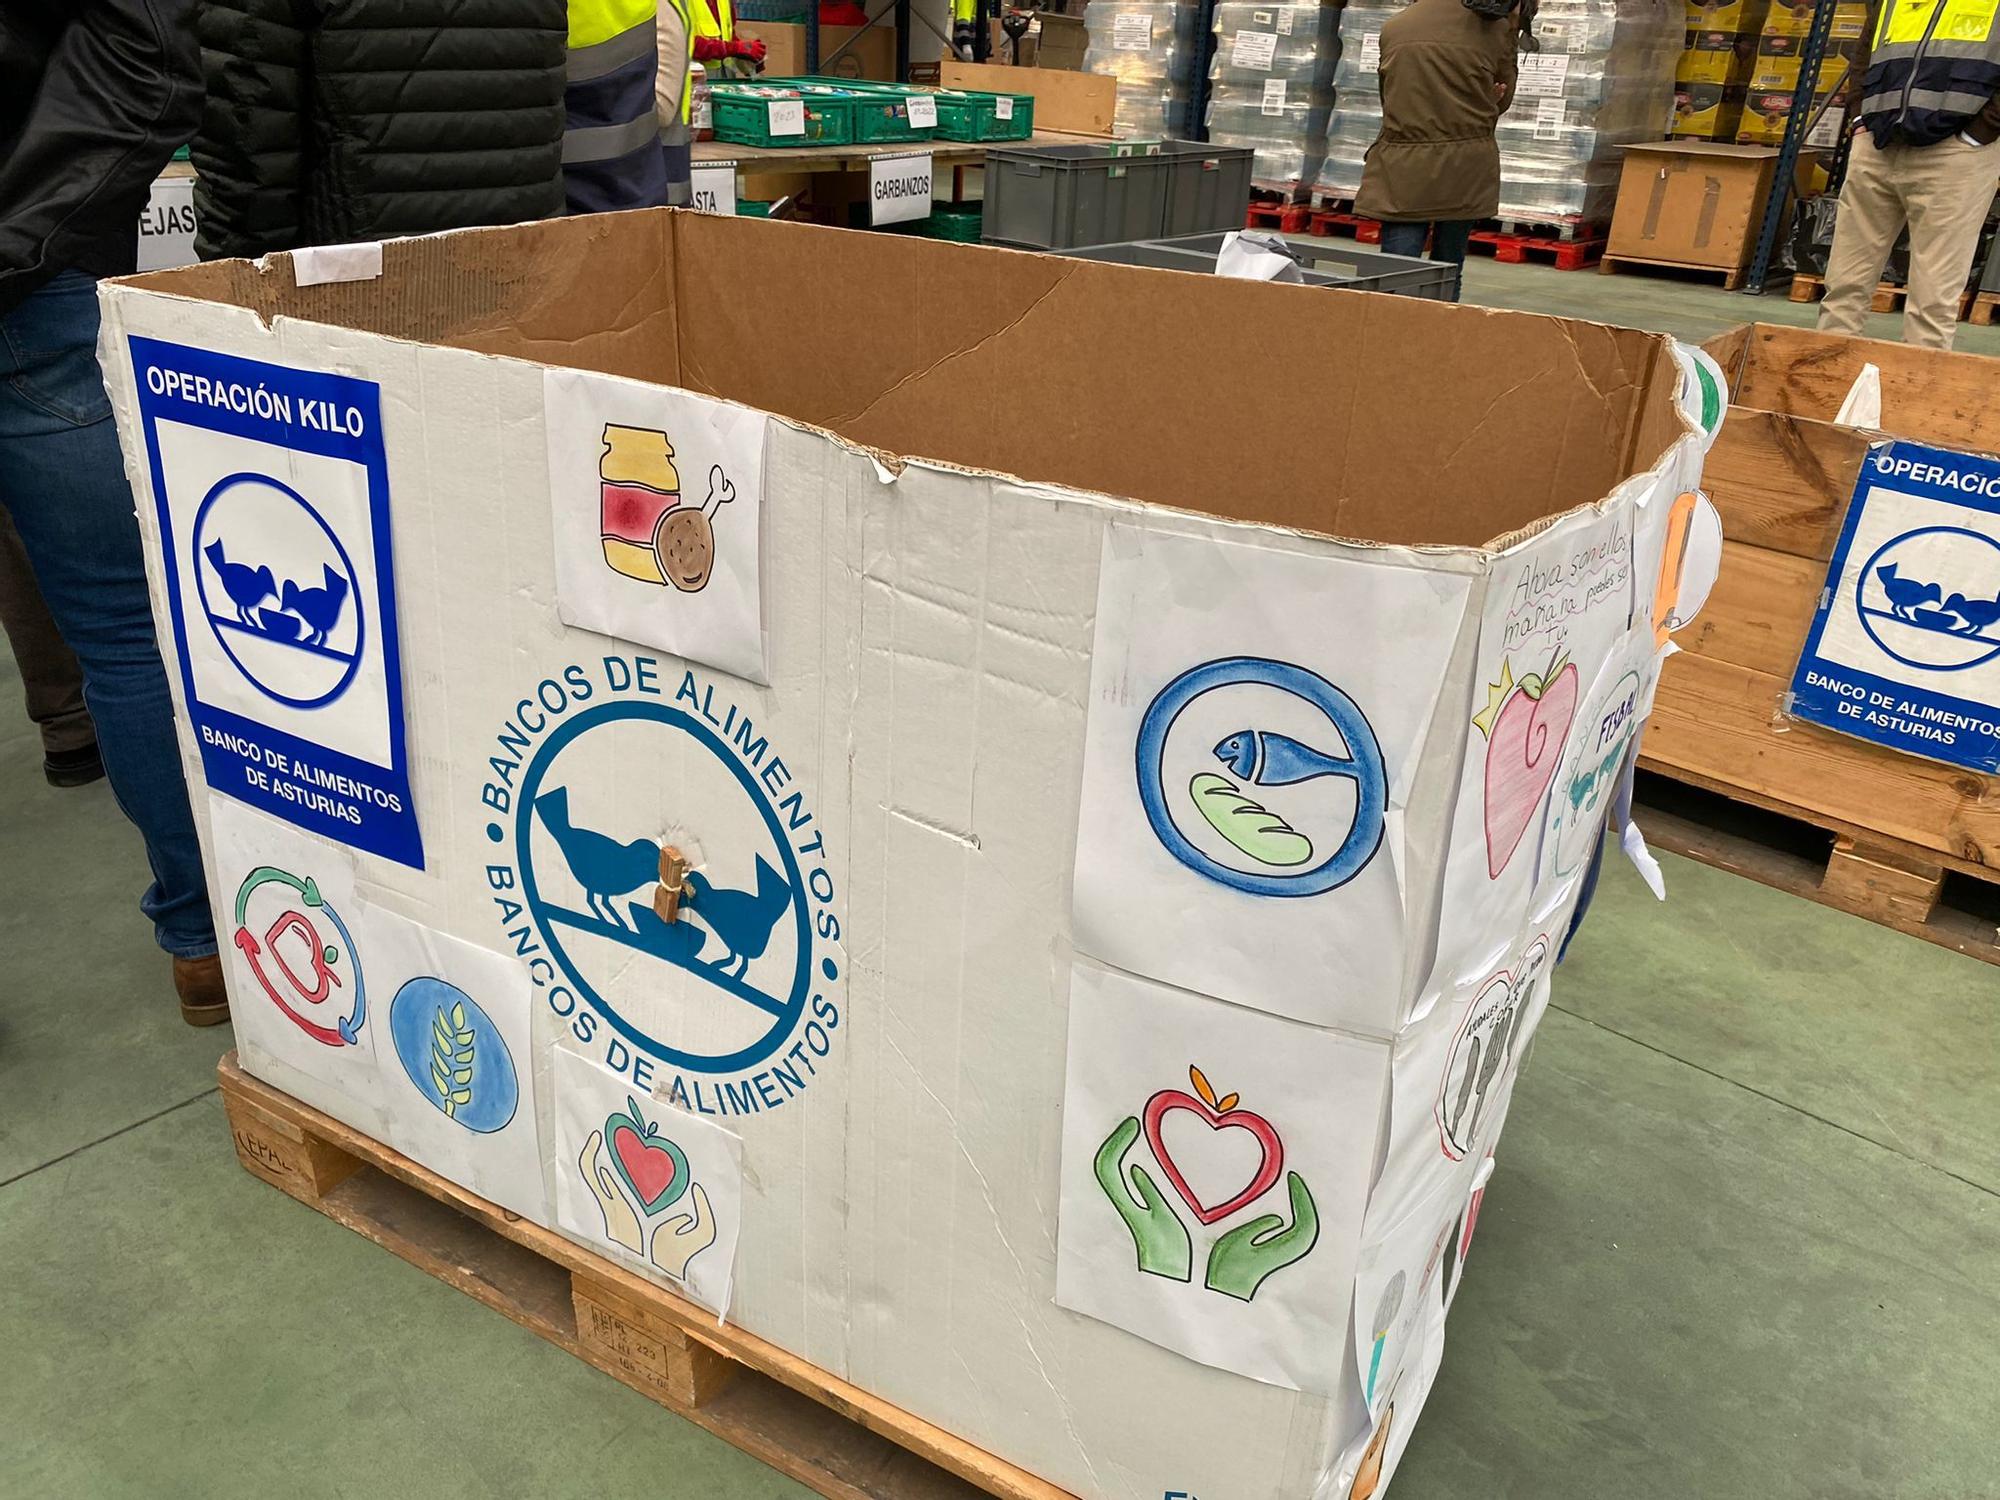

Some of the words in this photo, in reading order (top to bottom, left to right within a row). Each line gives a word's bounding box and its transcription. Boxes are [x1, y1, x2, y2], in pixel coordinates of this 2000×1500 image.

[874, 174, 930, 201] GARBANZOS
[145, 364, 293, 425] OPERACIÓN
[297, 397, 364, 439] KILO
[1570, 546, 1597, 577] son
[1805, 670, 1867, 701] BANCO
[1868, 691, 1896, 711] DE
[1837, 700, 1864, 719] DE
[1864, 711, 1957, 746] ASTURIAS
[201, 724, 262, 763] BANCO
[264, 747, 290, 774] DE
[293, 760, 403, 814] ALIMENTOS
[245, 765, 270, 792] DE
[272, 777, 363, 825] ASTURIAS
[481, 664, 594, 815] BANCOS
[602, 655, 662, 695] DE
[675, 670, 841, 943] ALIMENTOS
[485, 864, 598, 1044] BANCOS
[605, 1037, 656, 1094] DE
[668, 993, 840, 1116] ALIMENTOS
